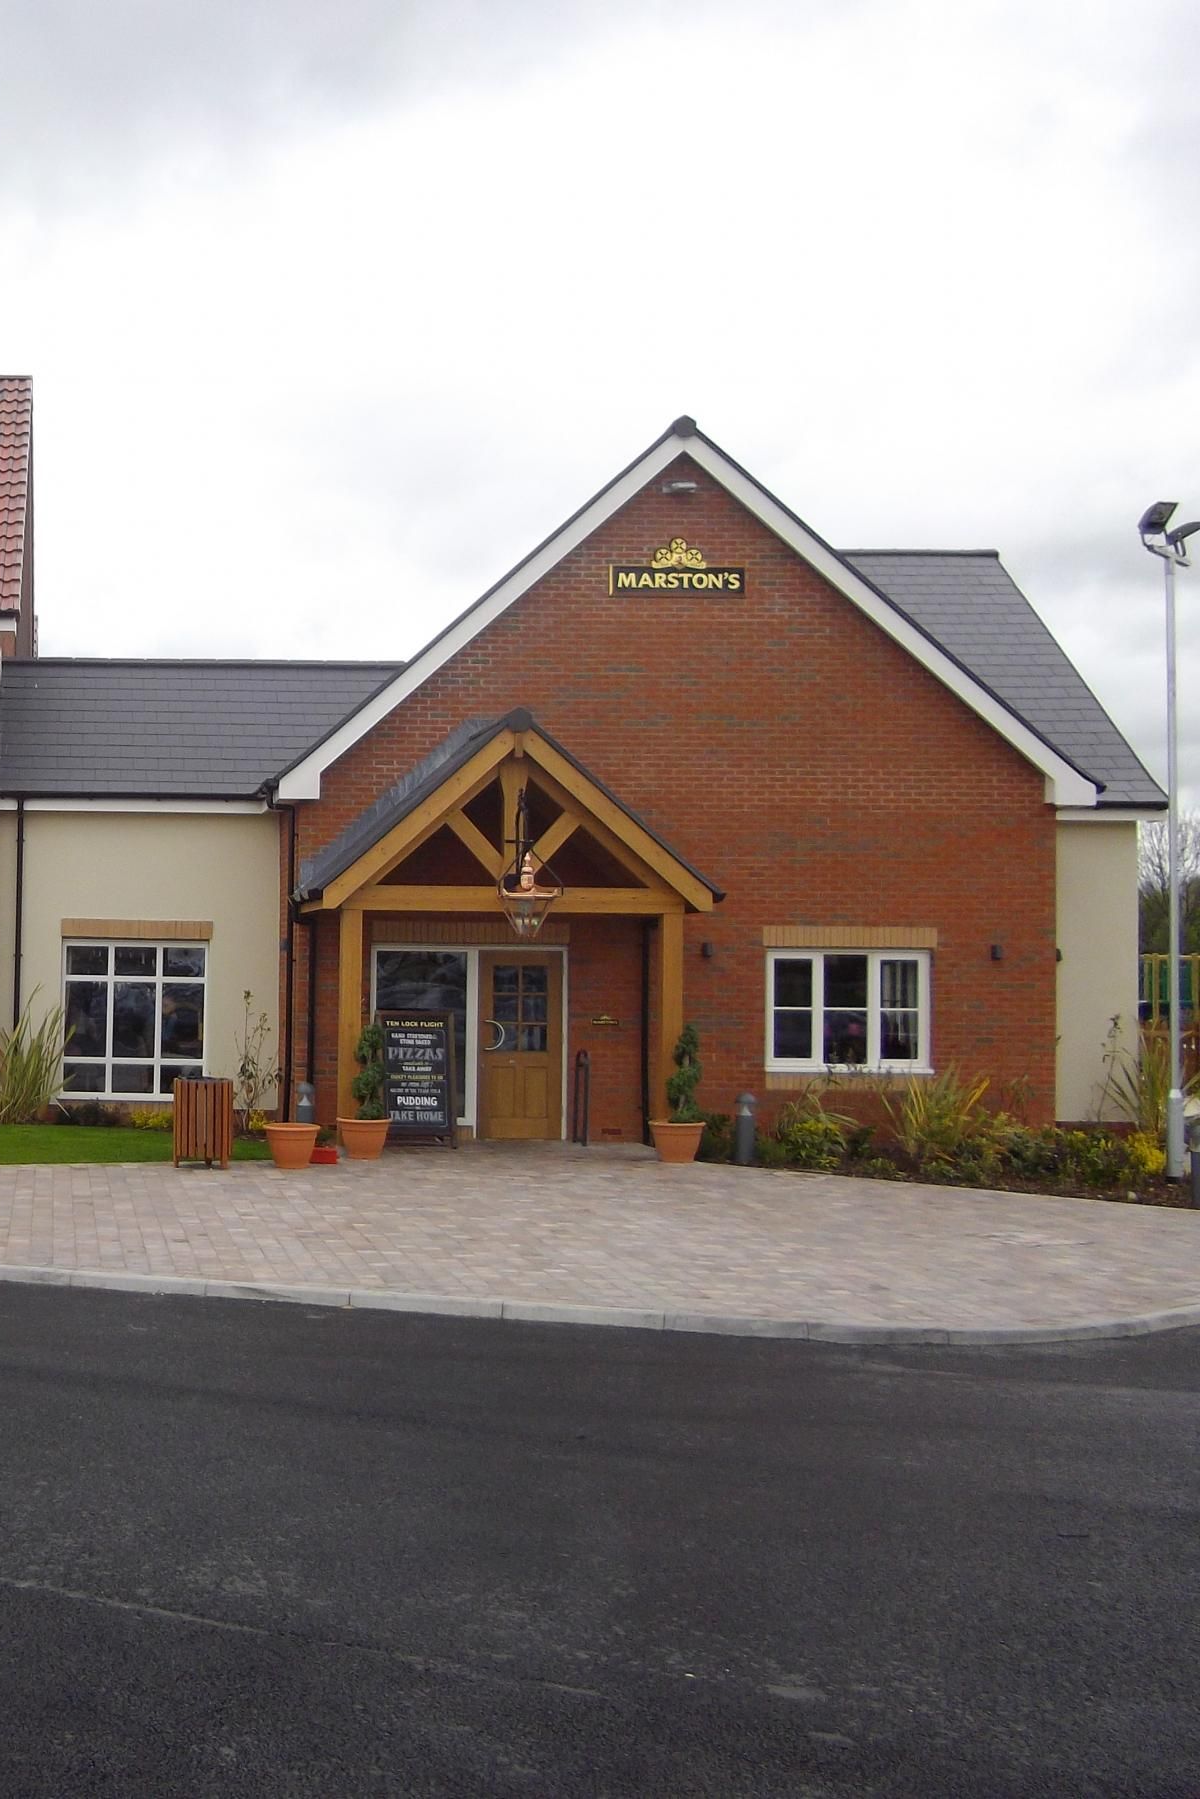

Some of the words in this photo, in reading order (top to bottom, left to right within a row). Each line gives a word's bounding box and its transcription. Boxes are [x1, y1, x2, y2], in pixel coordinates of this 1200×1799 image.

[617, 571, 741, 590] MARSTON'S
[387, 1047, 445, 1060] PIZZAS
[397, 1096, 438, 1106] PUDDING
[390, 1110, 415, 1121] TAKE
[416, 1111, 444, 1121] HOME
